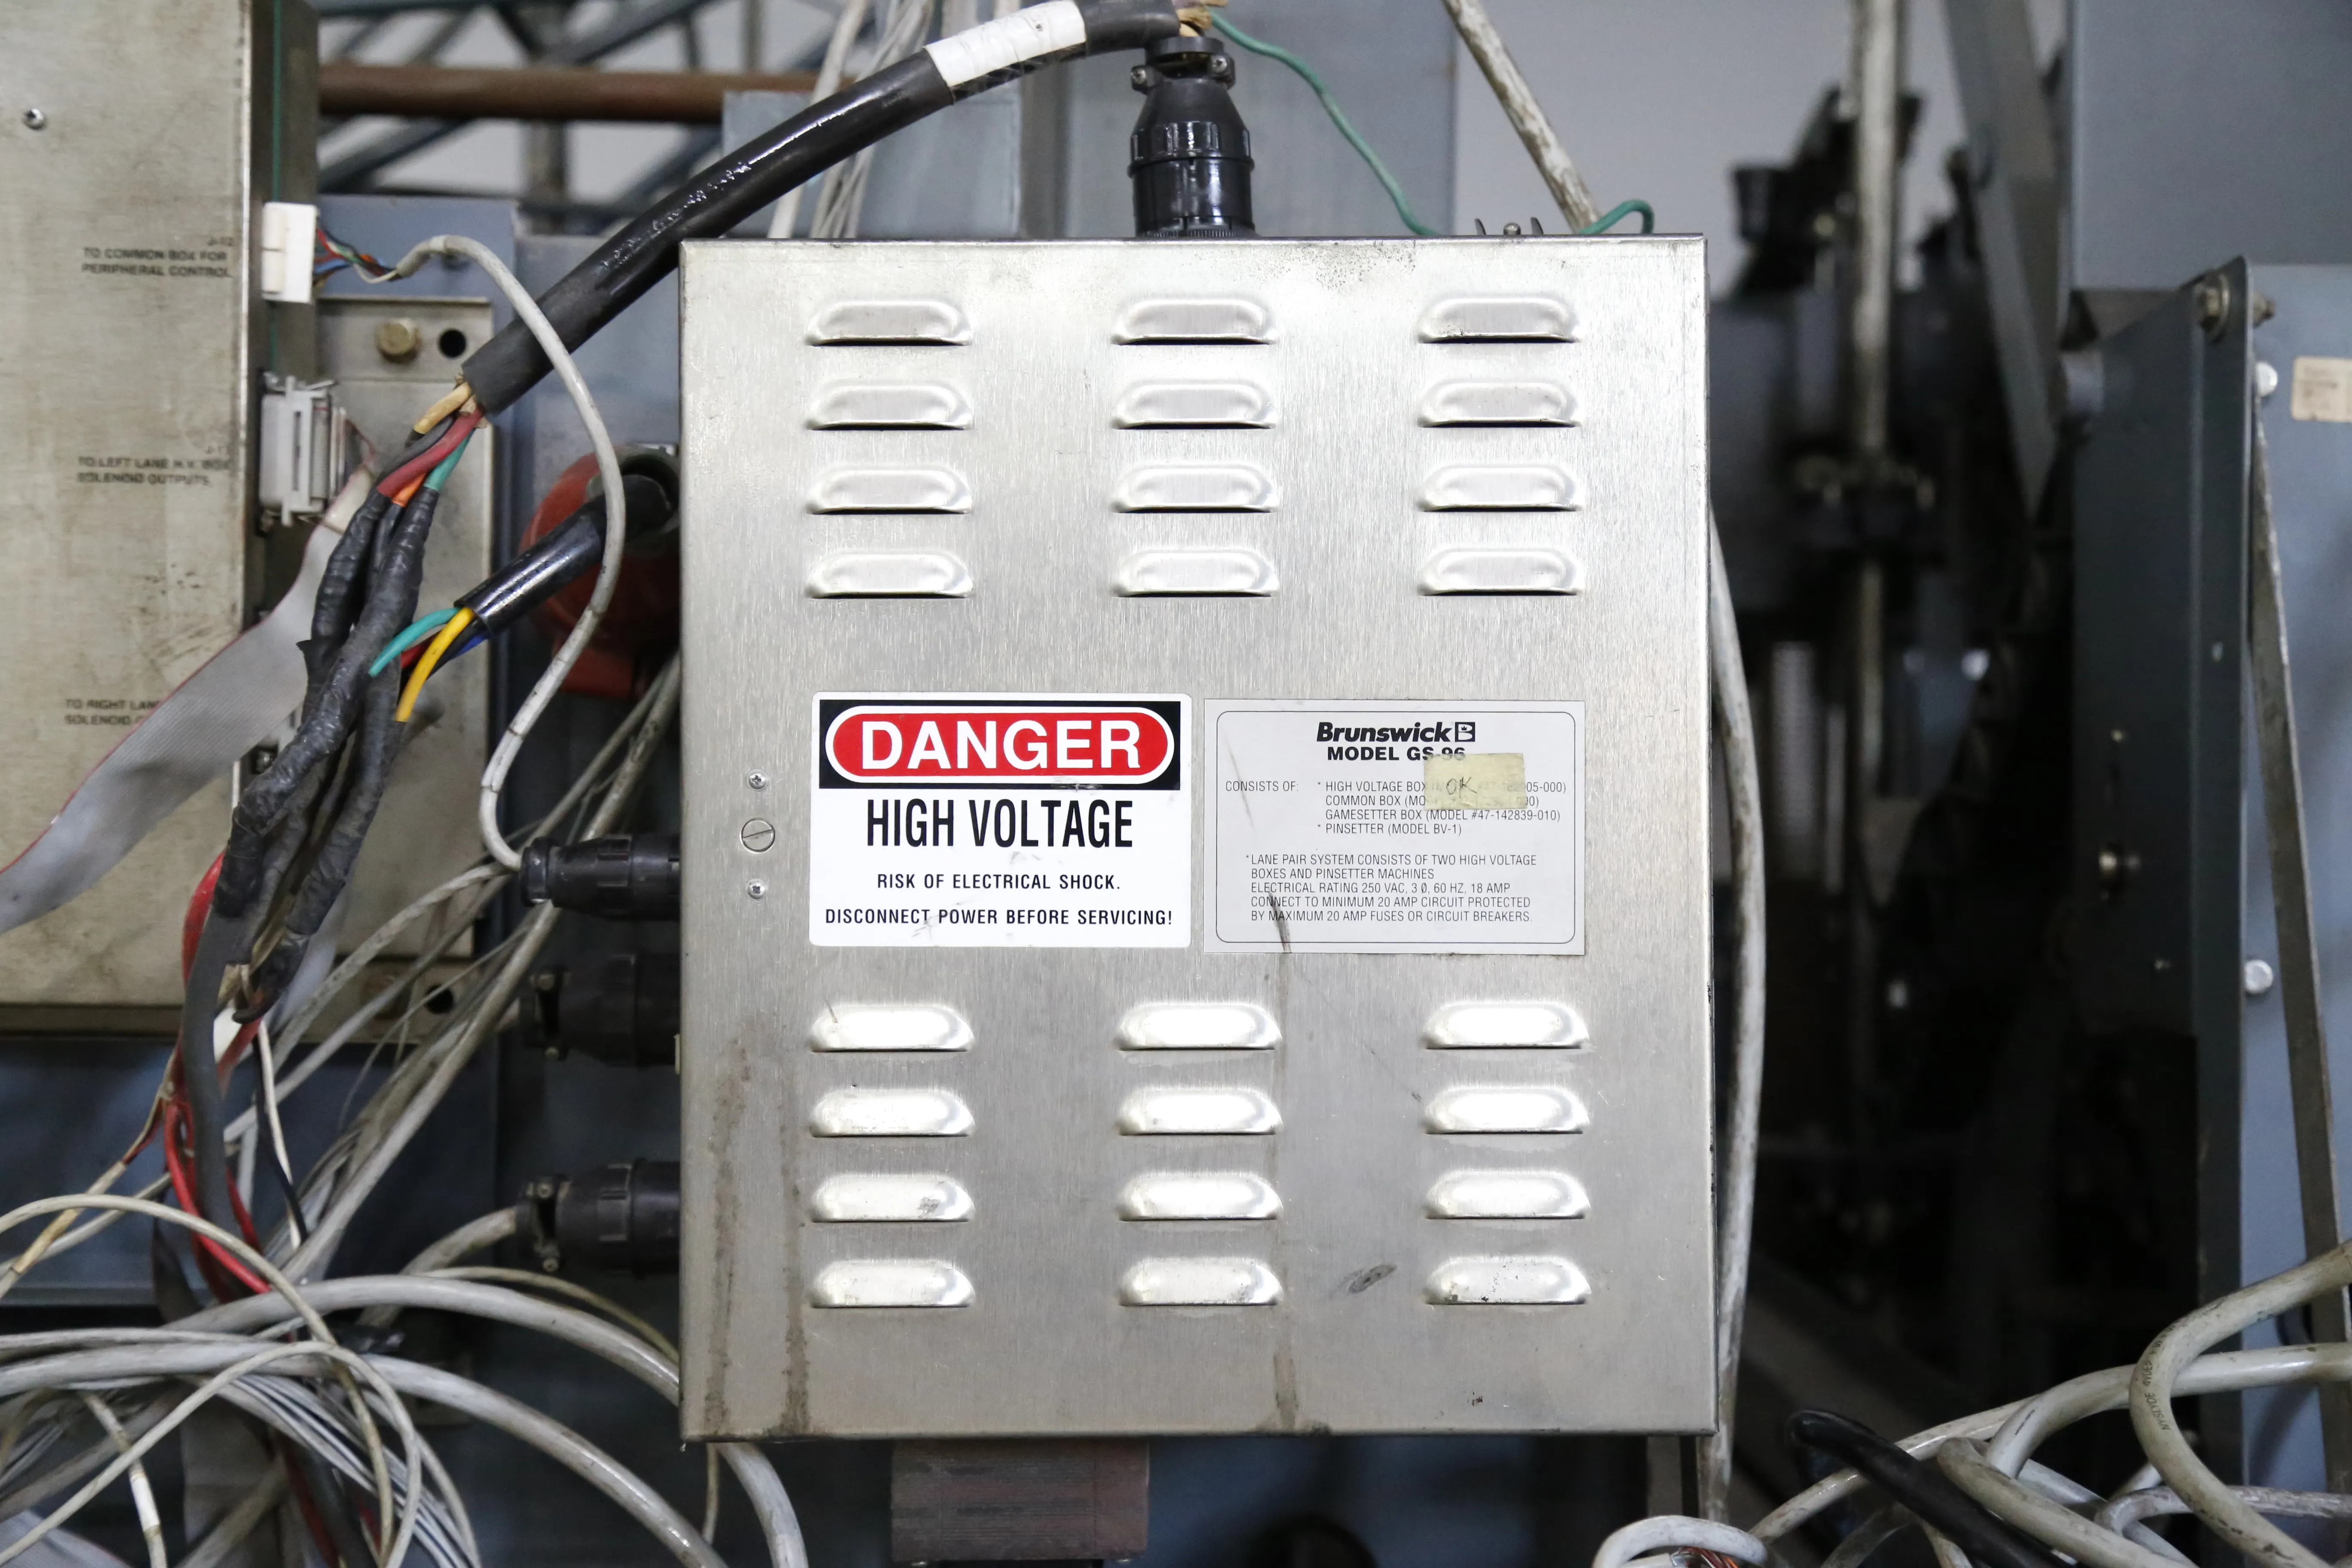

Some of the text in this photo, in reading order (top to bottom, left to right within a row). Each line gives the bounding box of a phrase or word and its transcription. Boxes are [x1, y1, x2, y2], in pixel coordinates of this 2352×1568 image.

[84, 248, 227, 261] TO COMMON BOX FOR
[82, 263, 164, 276] PERIPHERAL
[78, 456, 95, 468] TO
[98, 457, 131, 468] LEFT
[135, 458, 168, 469] LANE
[77, 472, 144, 484] SOLENOID
[66, 698, 159, 710] TO RIGHT LAN
[64, 715, 131, 726] SOLENOID
[1316, 722, 1453, 742] Brunswick
[861, 720, 1141, 770] DANGER
[1328, 746, 1400, 761] MODEL
[1225, 781, 1299, 791] CONSISTS OF:
[1326, 781, 1352, 792] HIGH
[1356, 781, 1403, 792] VOLTAGE
[1407, 781, 1426, 792] BOX
[1446, 777, 1477, 798] OK
[1326, 795, 1375, 806] COMMON
[1380, 795, 1400, 805] BOX
[1326, 809, 1561, 822] GAMESETTER BOX (MODEL #47-142839-010)
[867, 798, 1133, 848] HIGH VOLTAGE
[1326, 823, 1462, 836] PINSETTER (MODEL BV-1)
[1251, 854, 1536, 866] LANE PAIR SYSTEM CONSISTS OF TWO HIGH VOLTAGE
[1252, 868, 1434, 879] BOXES AND PINSETTER MACHINES
[878, 874, 1120, 889] RISK OF ELECTRICAL SHOCK.
[1251, 882, 1315, 893] ELECTRICAL
[1320, 882, 1358, 893] RATING
[1362, 882, 1381, 893] 250
[1384, 882, 1408, 894] VAC,
[1412, 883, 1417, 893] 3
[1434, 883, 1446, 893] 60
[1450, 883, 1467, 894] HZ,
[1471, 883, 1482, 893] 18
[1486, 883, 1510, 894] AMP
[1251, 896, 1530, 908] CONNECT TO MINIMUM 20 AMP CIRCUIT PROTECTED
[826, 909, 1171, 925] DISCONNECT POWER BEFORE SERVICING!
[1251, 910, 1531, 922] BY MAXIMUM 20 AMP FUSES OR CIRCUIT BREAKERS.
